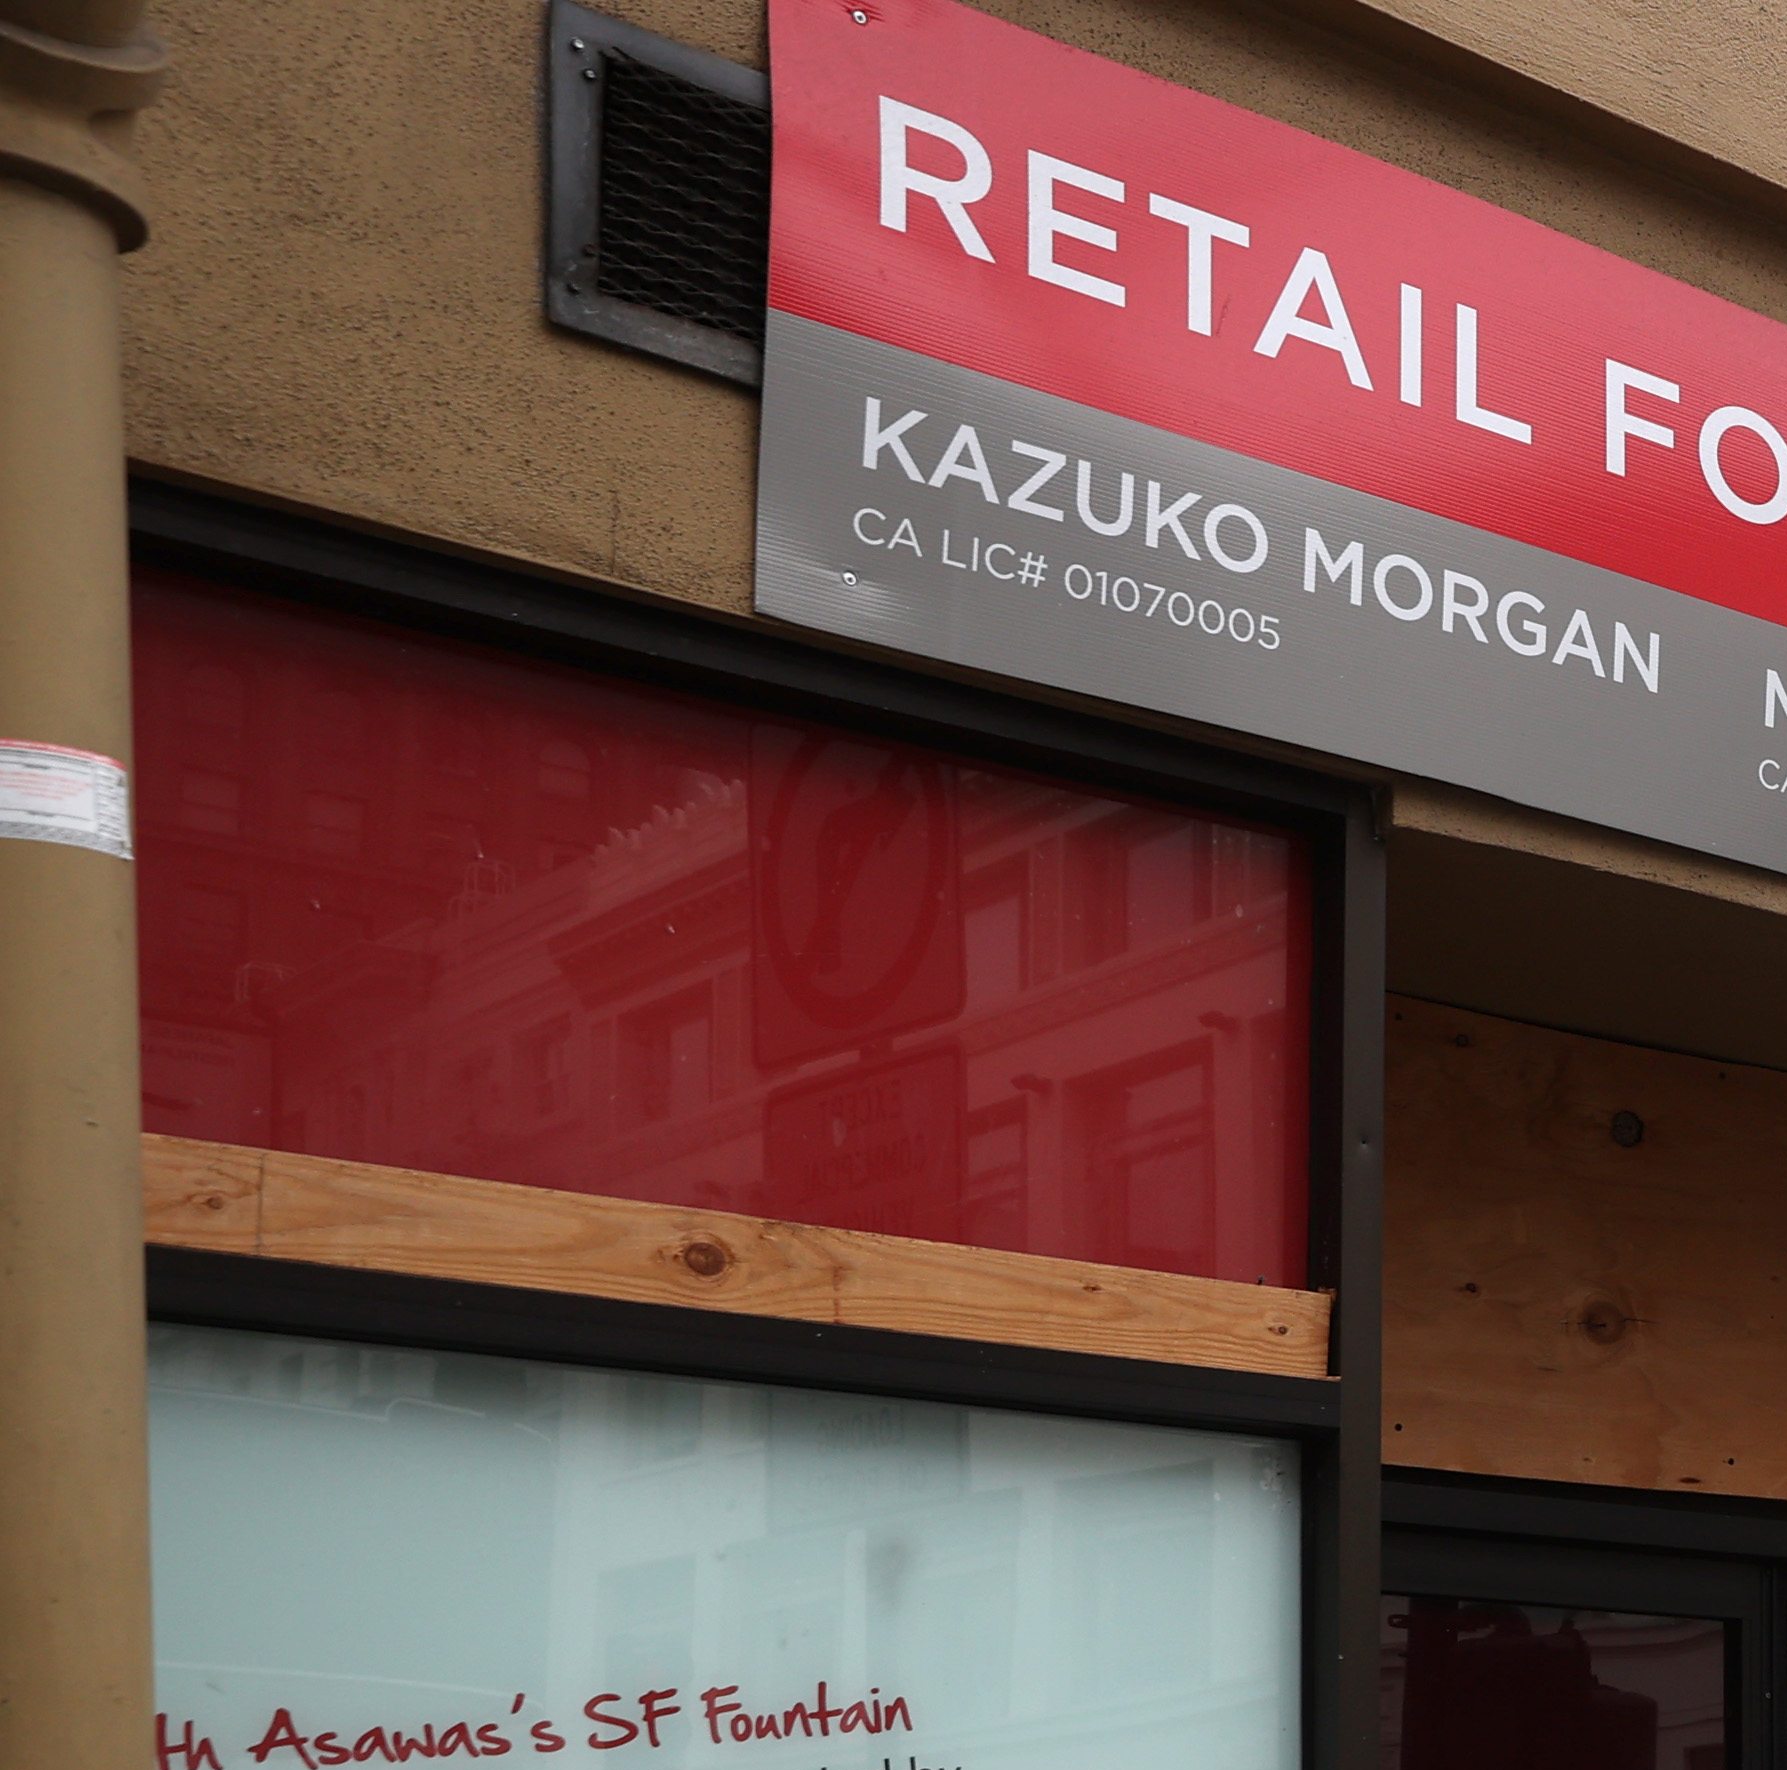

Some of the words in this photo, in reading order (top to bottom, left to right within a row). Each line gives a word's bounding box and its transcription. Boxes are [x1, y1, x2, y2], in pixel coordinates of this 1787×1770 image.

[878, 95, 1532, 444] RETAIL
[853, 507, 922, 558] CA
[942, 528, 1047, 589] LIC#
[1065, 562, 1281, 651] 01070005
[862, 396, 1268, 573] KAZUKO
[1303, 527, 1660, 694] MORGAN
[584, 1690, 681, 1753] SF
[704, 1681, 912, 1745] Fountain
